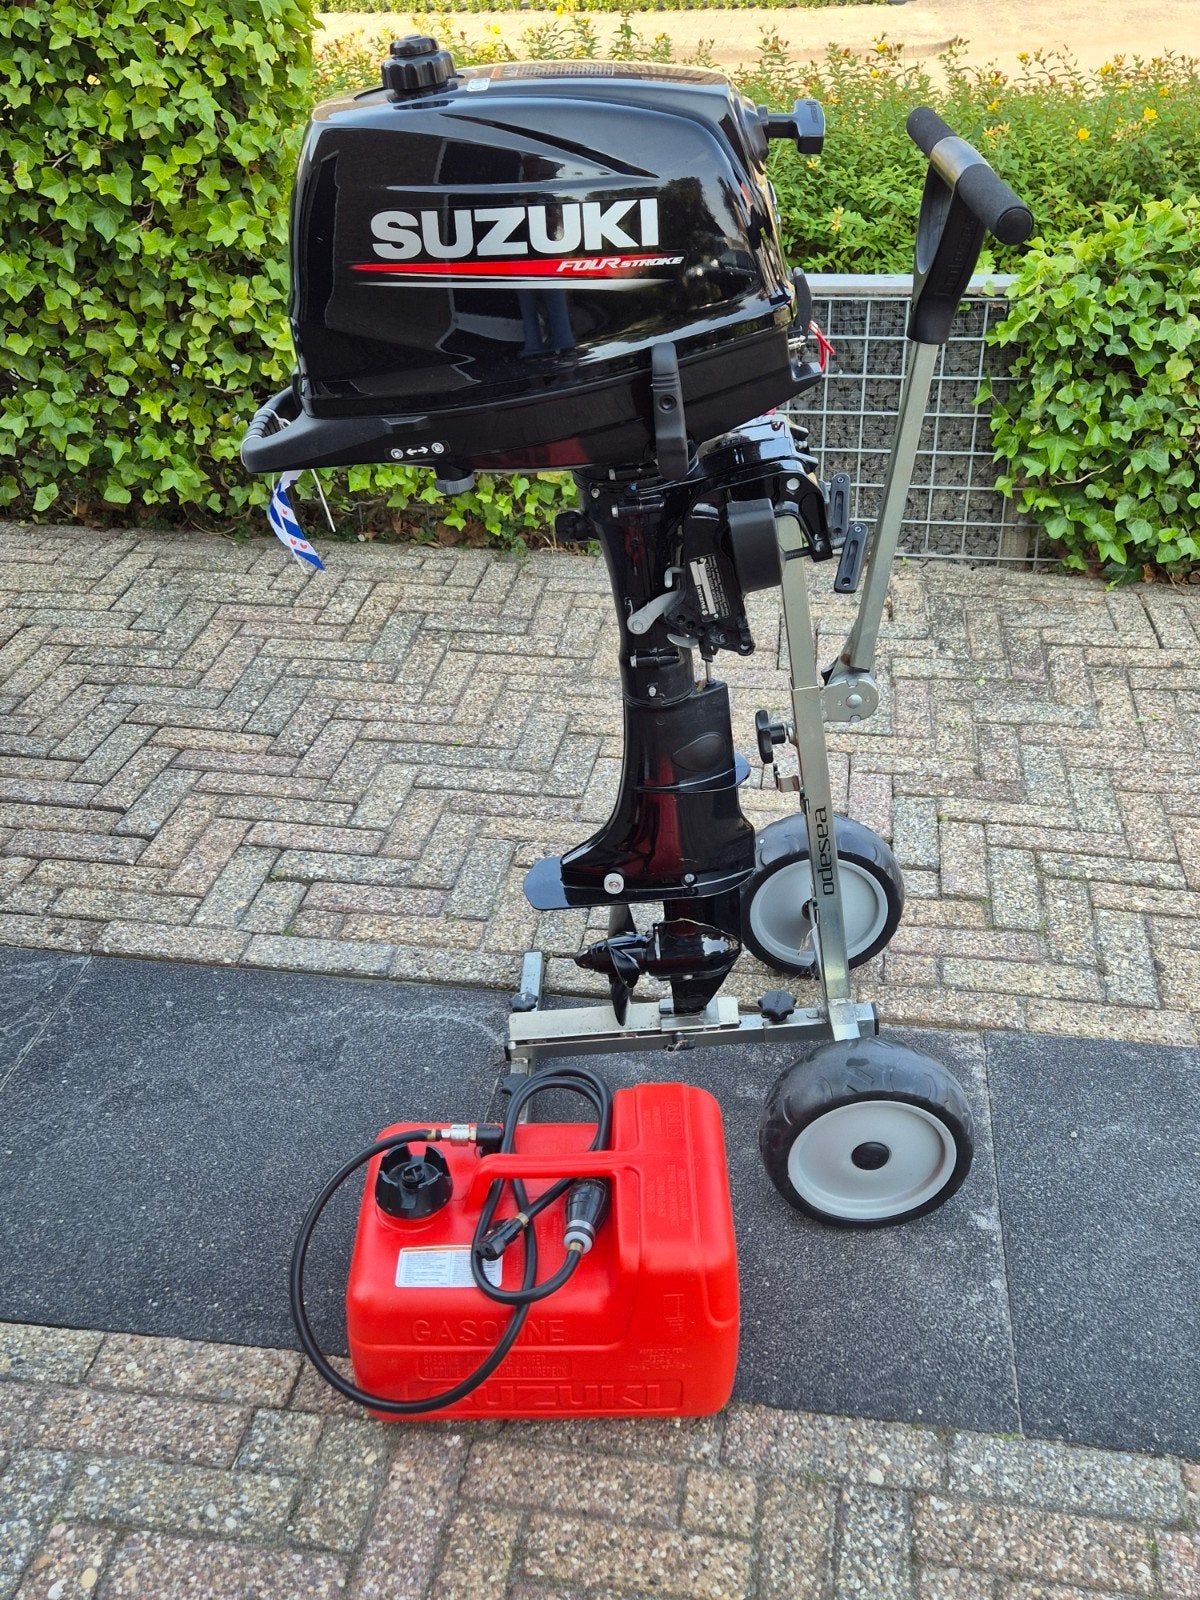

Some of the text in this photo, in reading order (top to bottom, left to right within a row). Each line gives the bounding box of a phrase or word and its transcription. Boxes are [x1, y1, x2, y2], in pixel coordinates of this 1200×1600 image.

[370, 198, 659, 260] SUZUKI
[556, 255, 685, 273] FOUR STROKE
[814, 805, 835, 896] odesea
